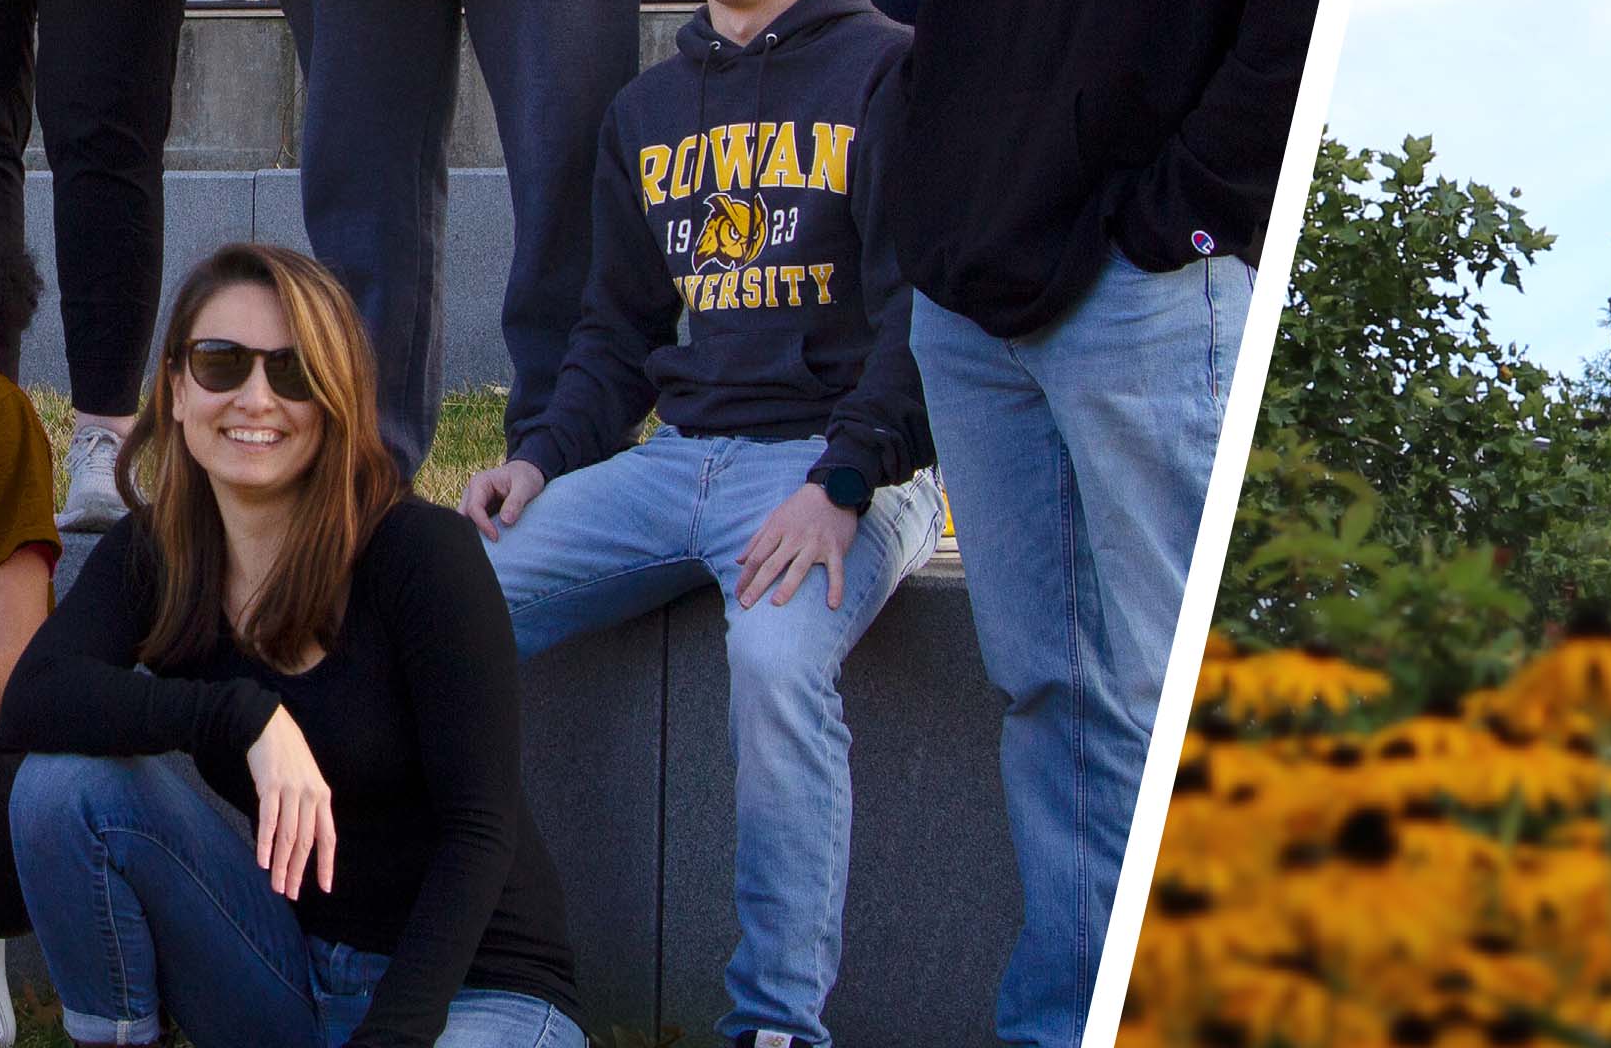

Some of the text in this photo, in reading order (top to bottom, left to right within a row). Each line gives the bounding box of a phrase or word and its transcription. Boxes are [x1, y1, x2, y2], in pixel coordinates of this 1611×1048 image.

[639, 121, 856, 216] ROWAN
[666, 206, 799, 254] 19 23
[673, 263, 835, 313] VERSITY
